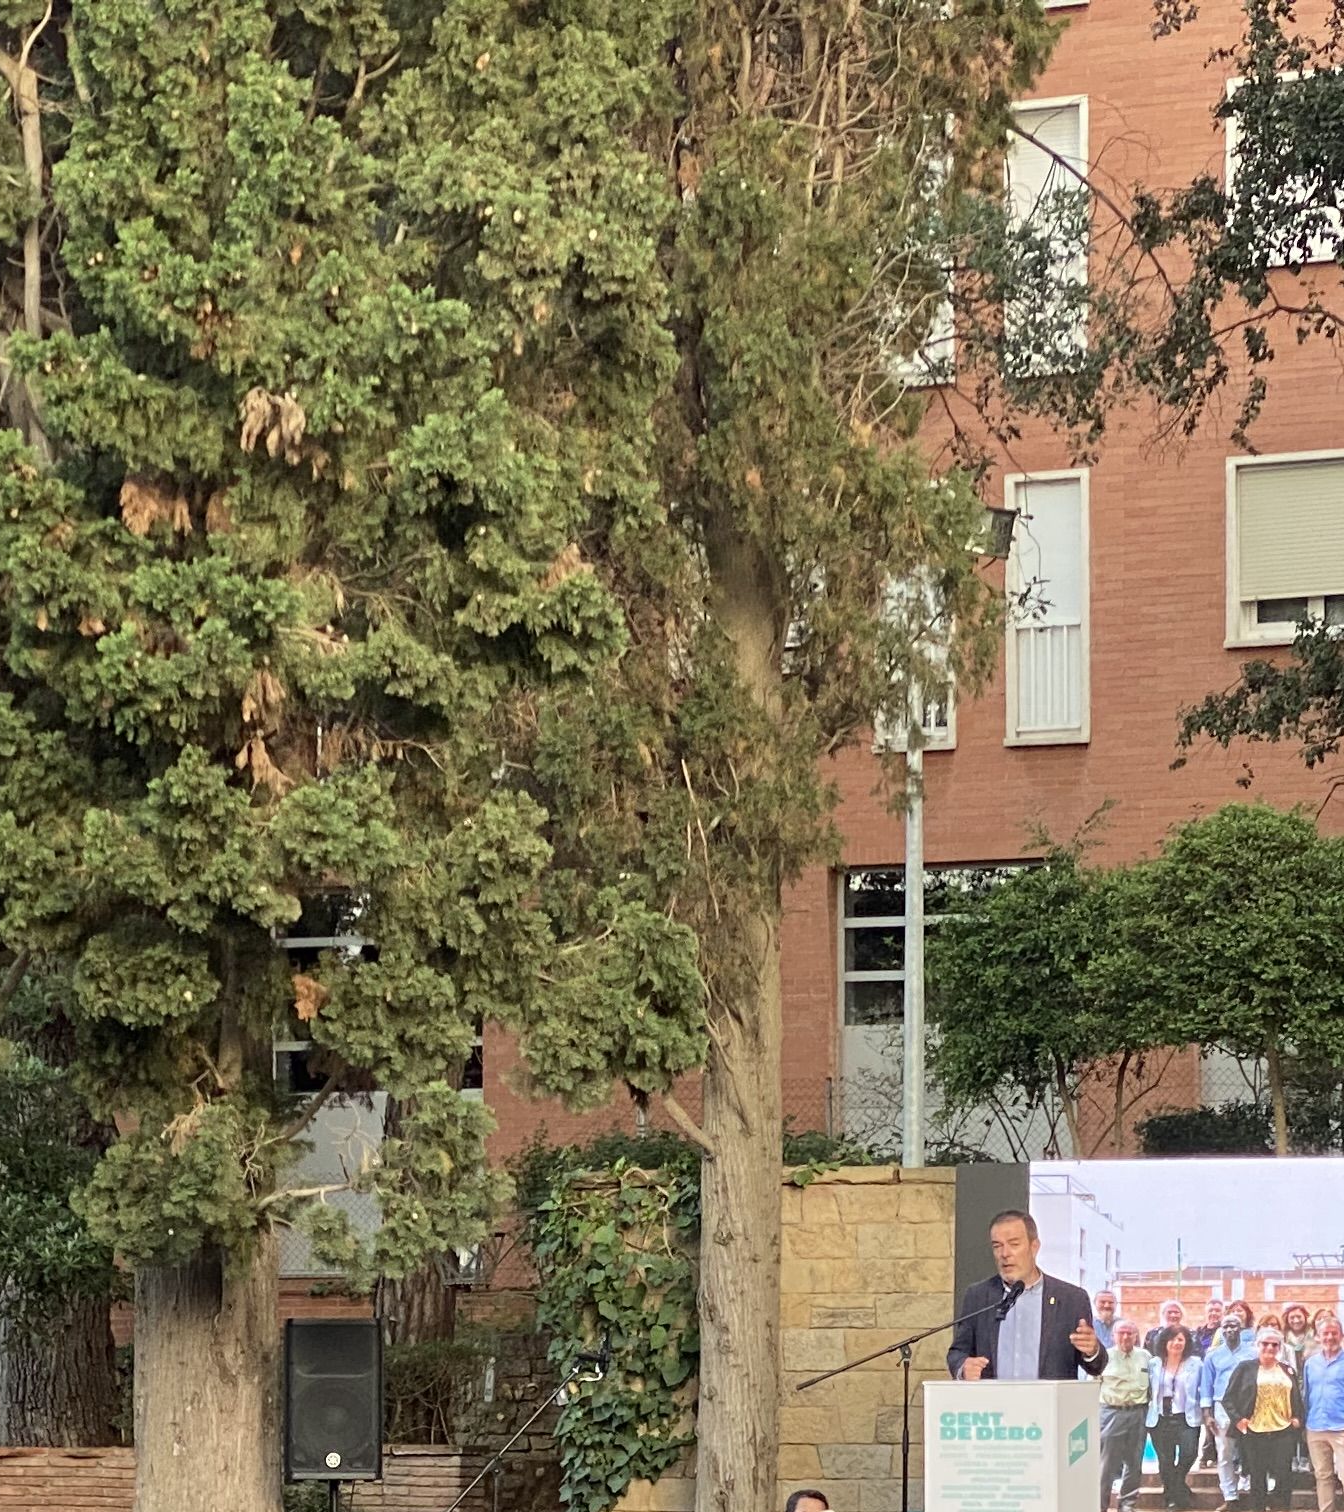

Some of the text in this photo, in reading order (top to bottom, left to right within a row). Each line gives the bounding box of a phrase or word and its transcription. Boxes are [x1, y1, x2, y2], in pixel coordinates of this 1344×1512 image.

[940, 1412, 1003, 1427] GENT
[940, 1422, 1042, 1440] DE DEBÒ
